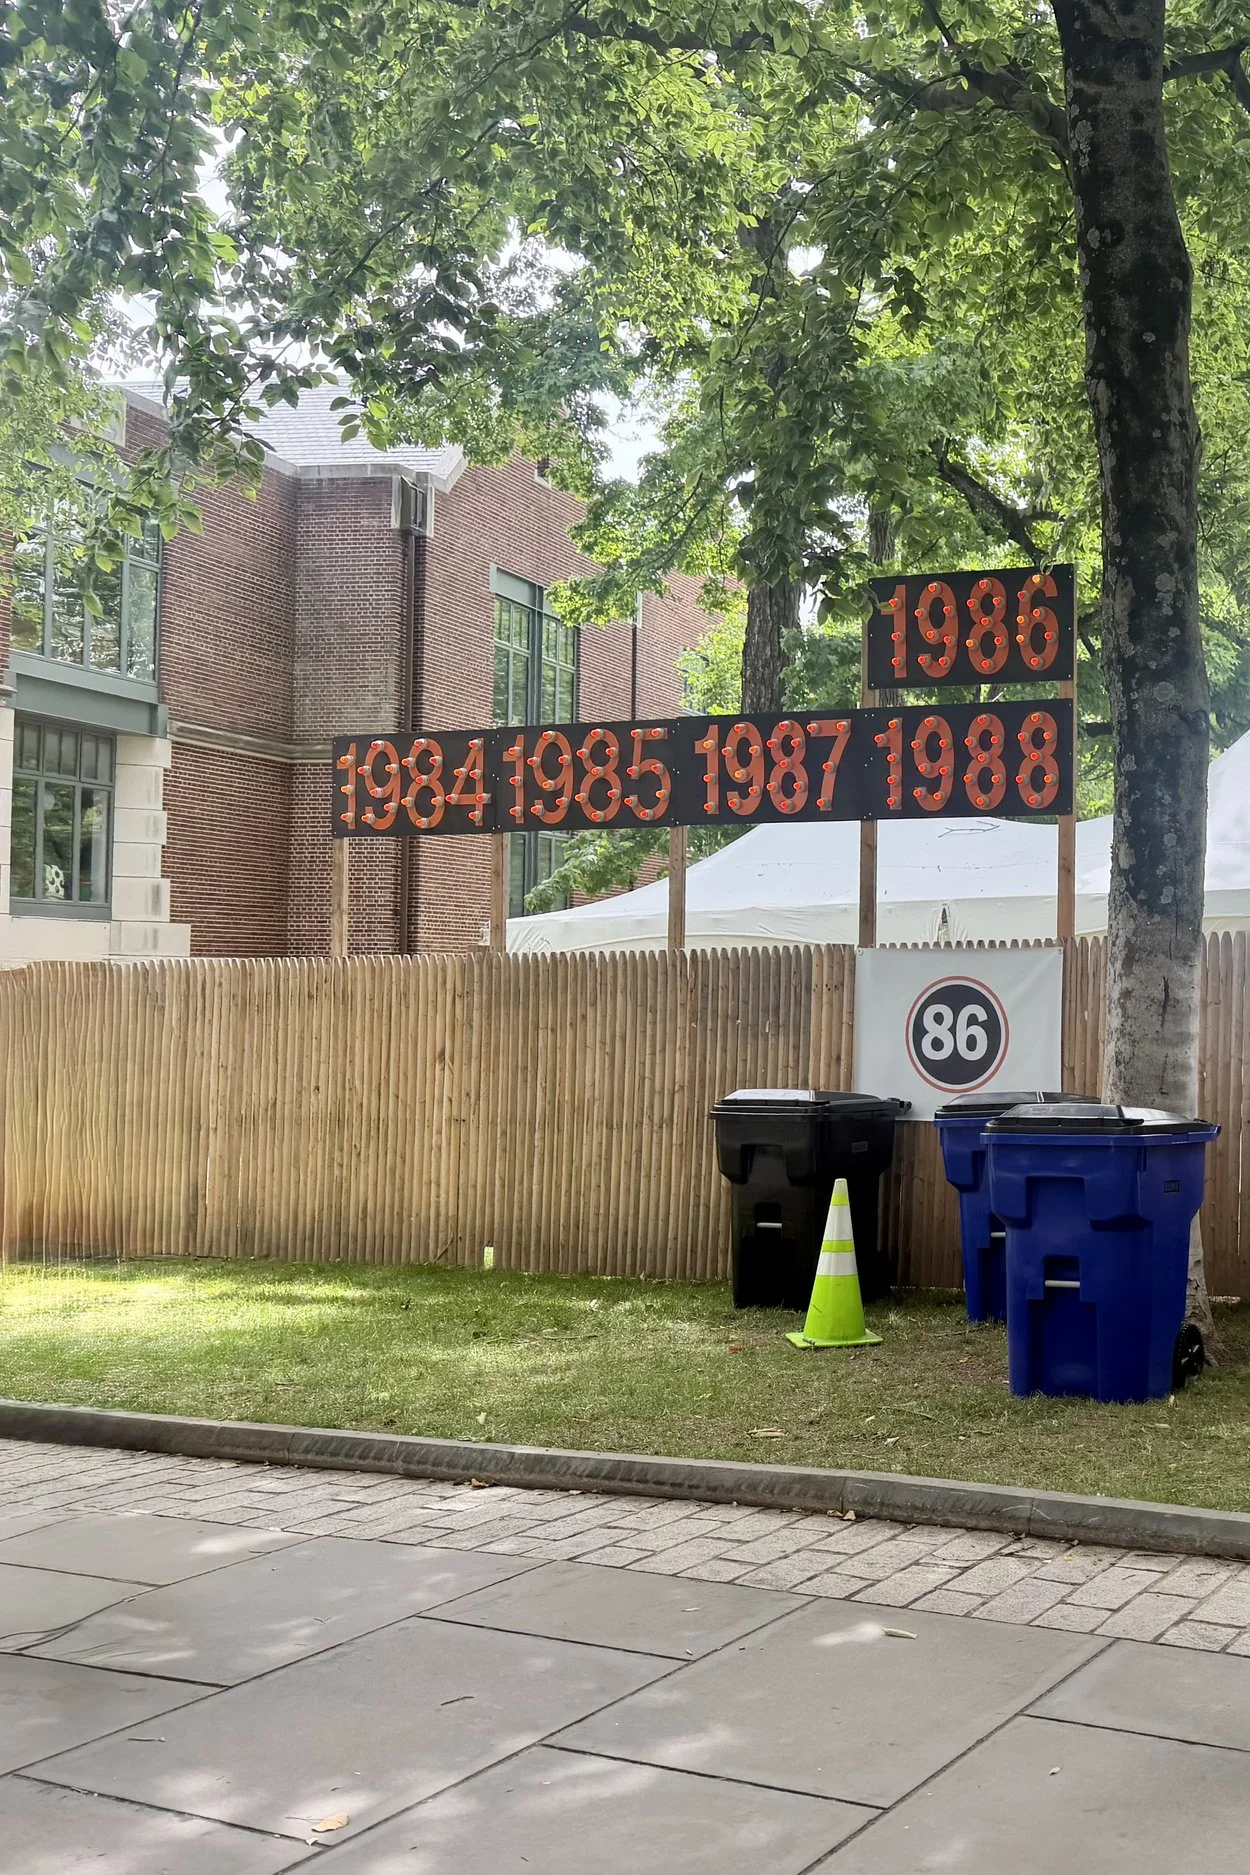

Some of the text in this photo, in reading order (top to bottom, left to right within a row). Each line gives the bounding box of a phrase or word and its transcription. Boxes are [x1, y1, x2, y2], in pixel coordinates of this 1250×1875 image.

[879, 573, 1059, 679] 1986
[336, 737, 490, 831] 1984
[501, 727, 673, 824] 1985
[694, 719, 852, 815] 1987
[874, 711, 1060, 811] 1988
[921, 1003, 989, 1061] 86
